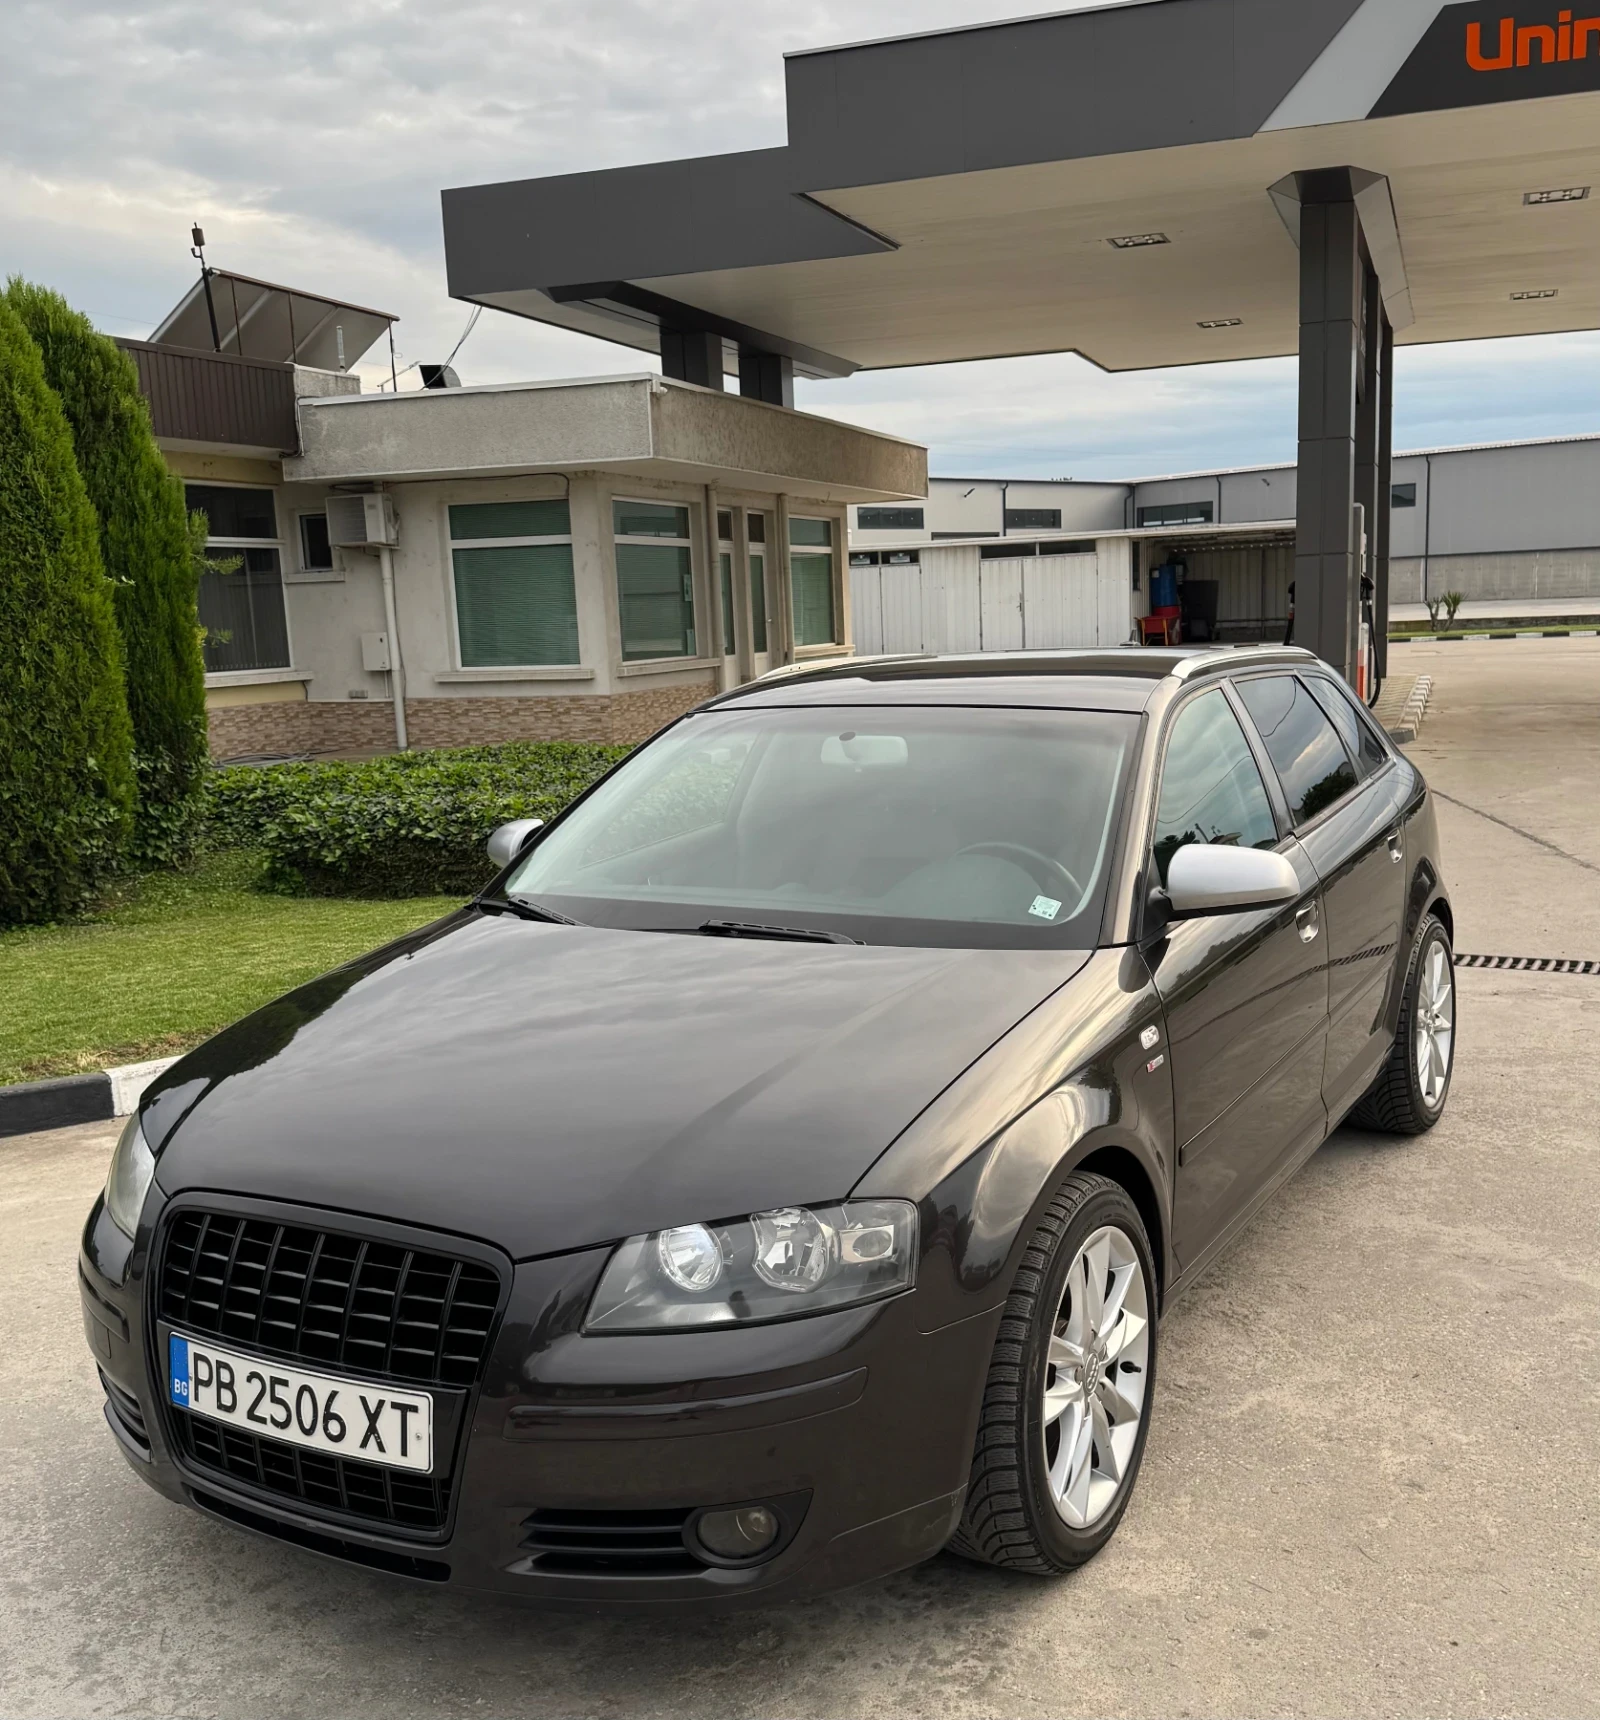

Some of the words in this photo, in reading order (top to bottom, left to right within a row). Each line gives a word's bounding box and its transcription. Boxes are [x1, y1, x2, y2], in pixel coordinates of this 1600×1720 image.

[174, 1377, 188, 1396] BG
[193, 1351, 238, 1414] PB
[246, 1370, 347, 1443] 2506
[359, 1394, 419, 1457] XT
